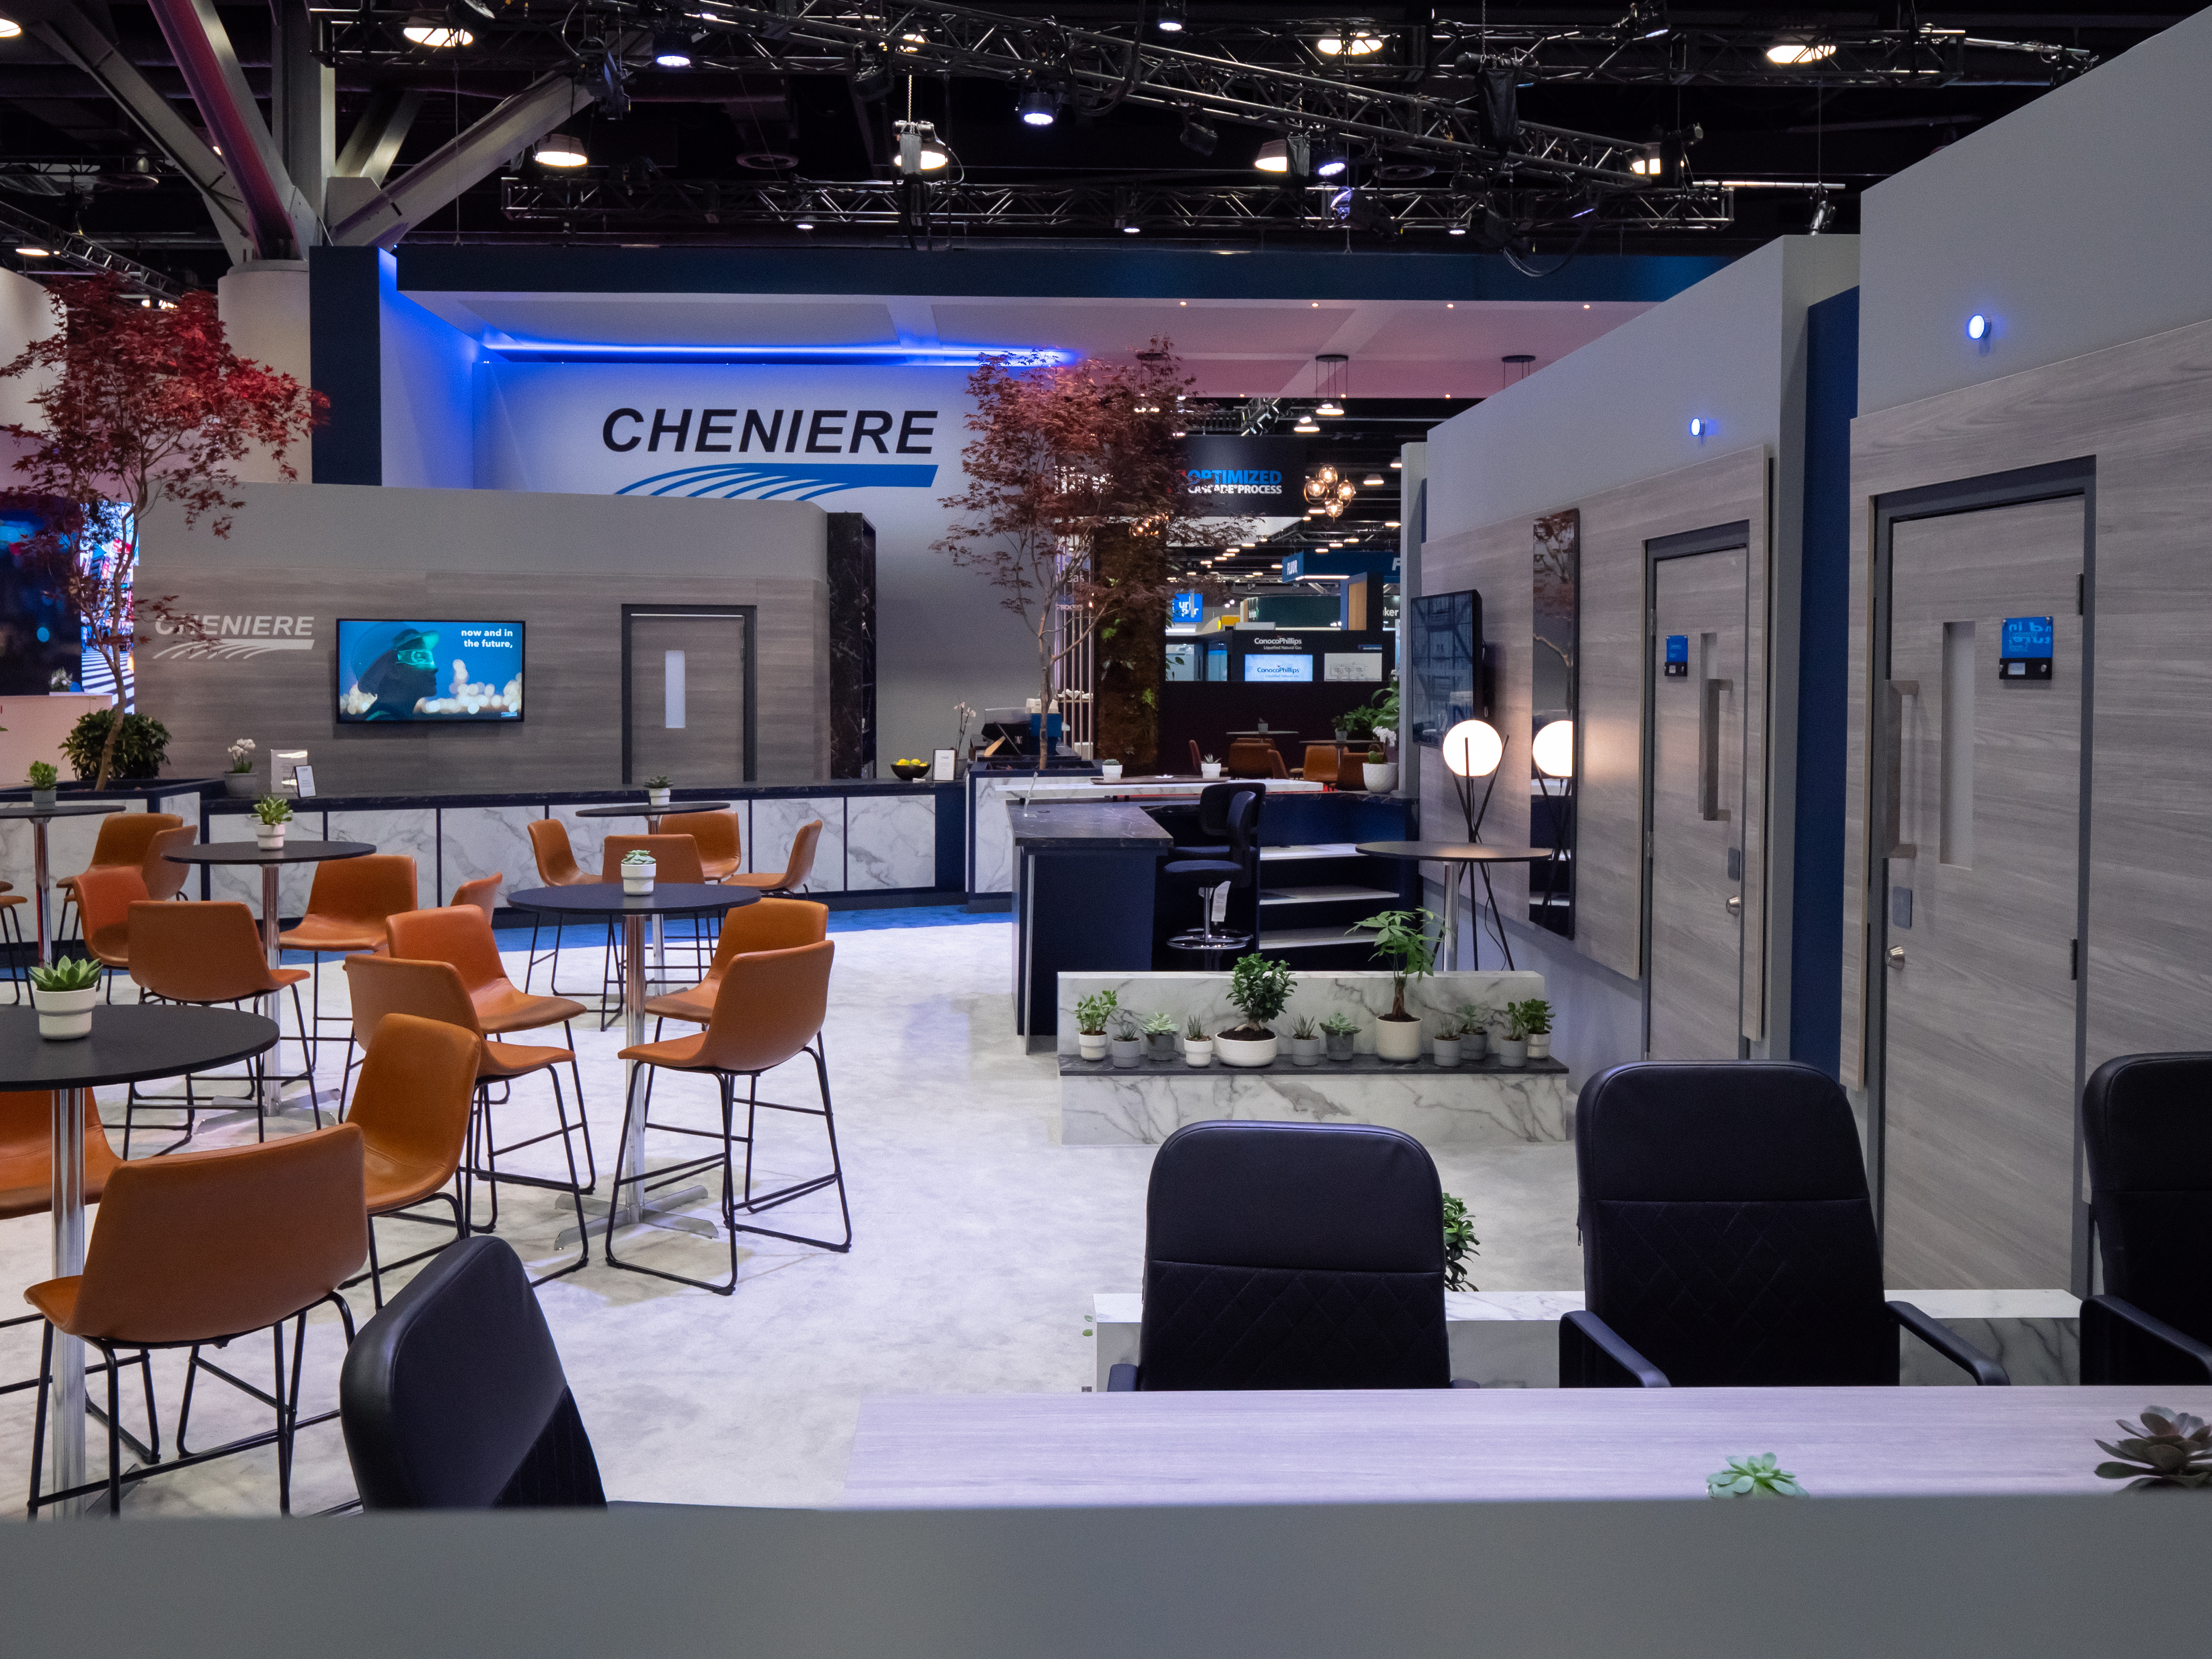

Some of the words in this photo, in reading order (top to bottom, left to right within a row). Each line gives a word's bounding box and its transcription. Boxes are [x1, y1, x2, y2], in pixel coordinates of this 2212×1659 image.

[602, 407, 939, 454] CHENIERE
[1187, 469, 1282, 485] OPTIMIZED
[1237, 485, 1282, 494] PROCESS
[1382, 606, 1399, 617] ker
[483, 628, 502, 637] and
[504, 629, 513, 637] in
[463, 639, 480, 647] the
[481, 639, 513, 649] future,
